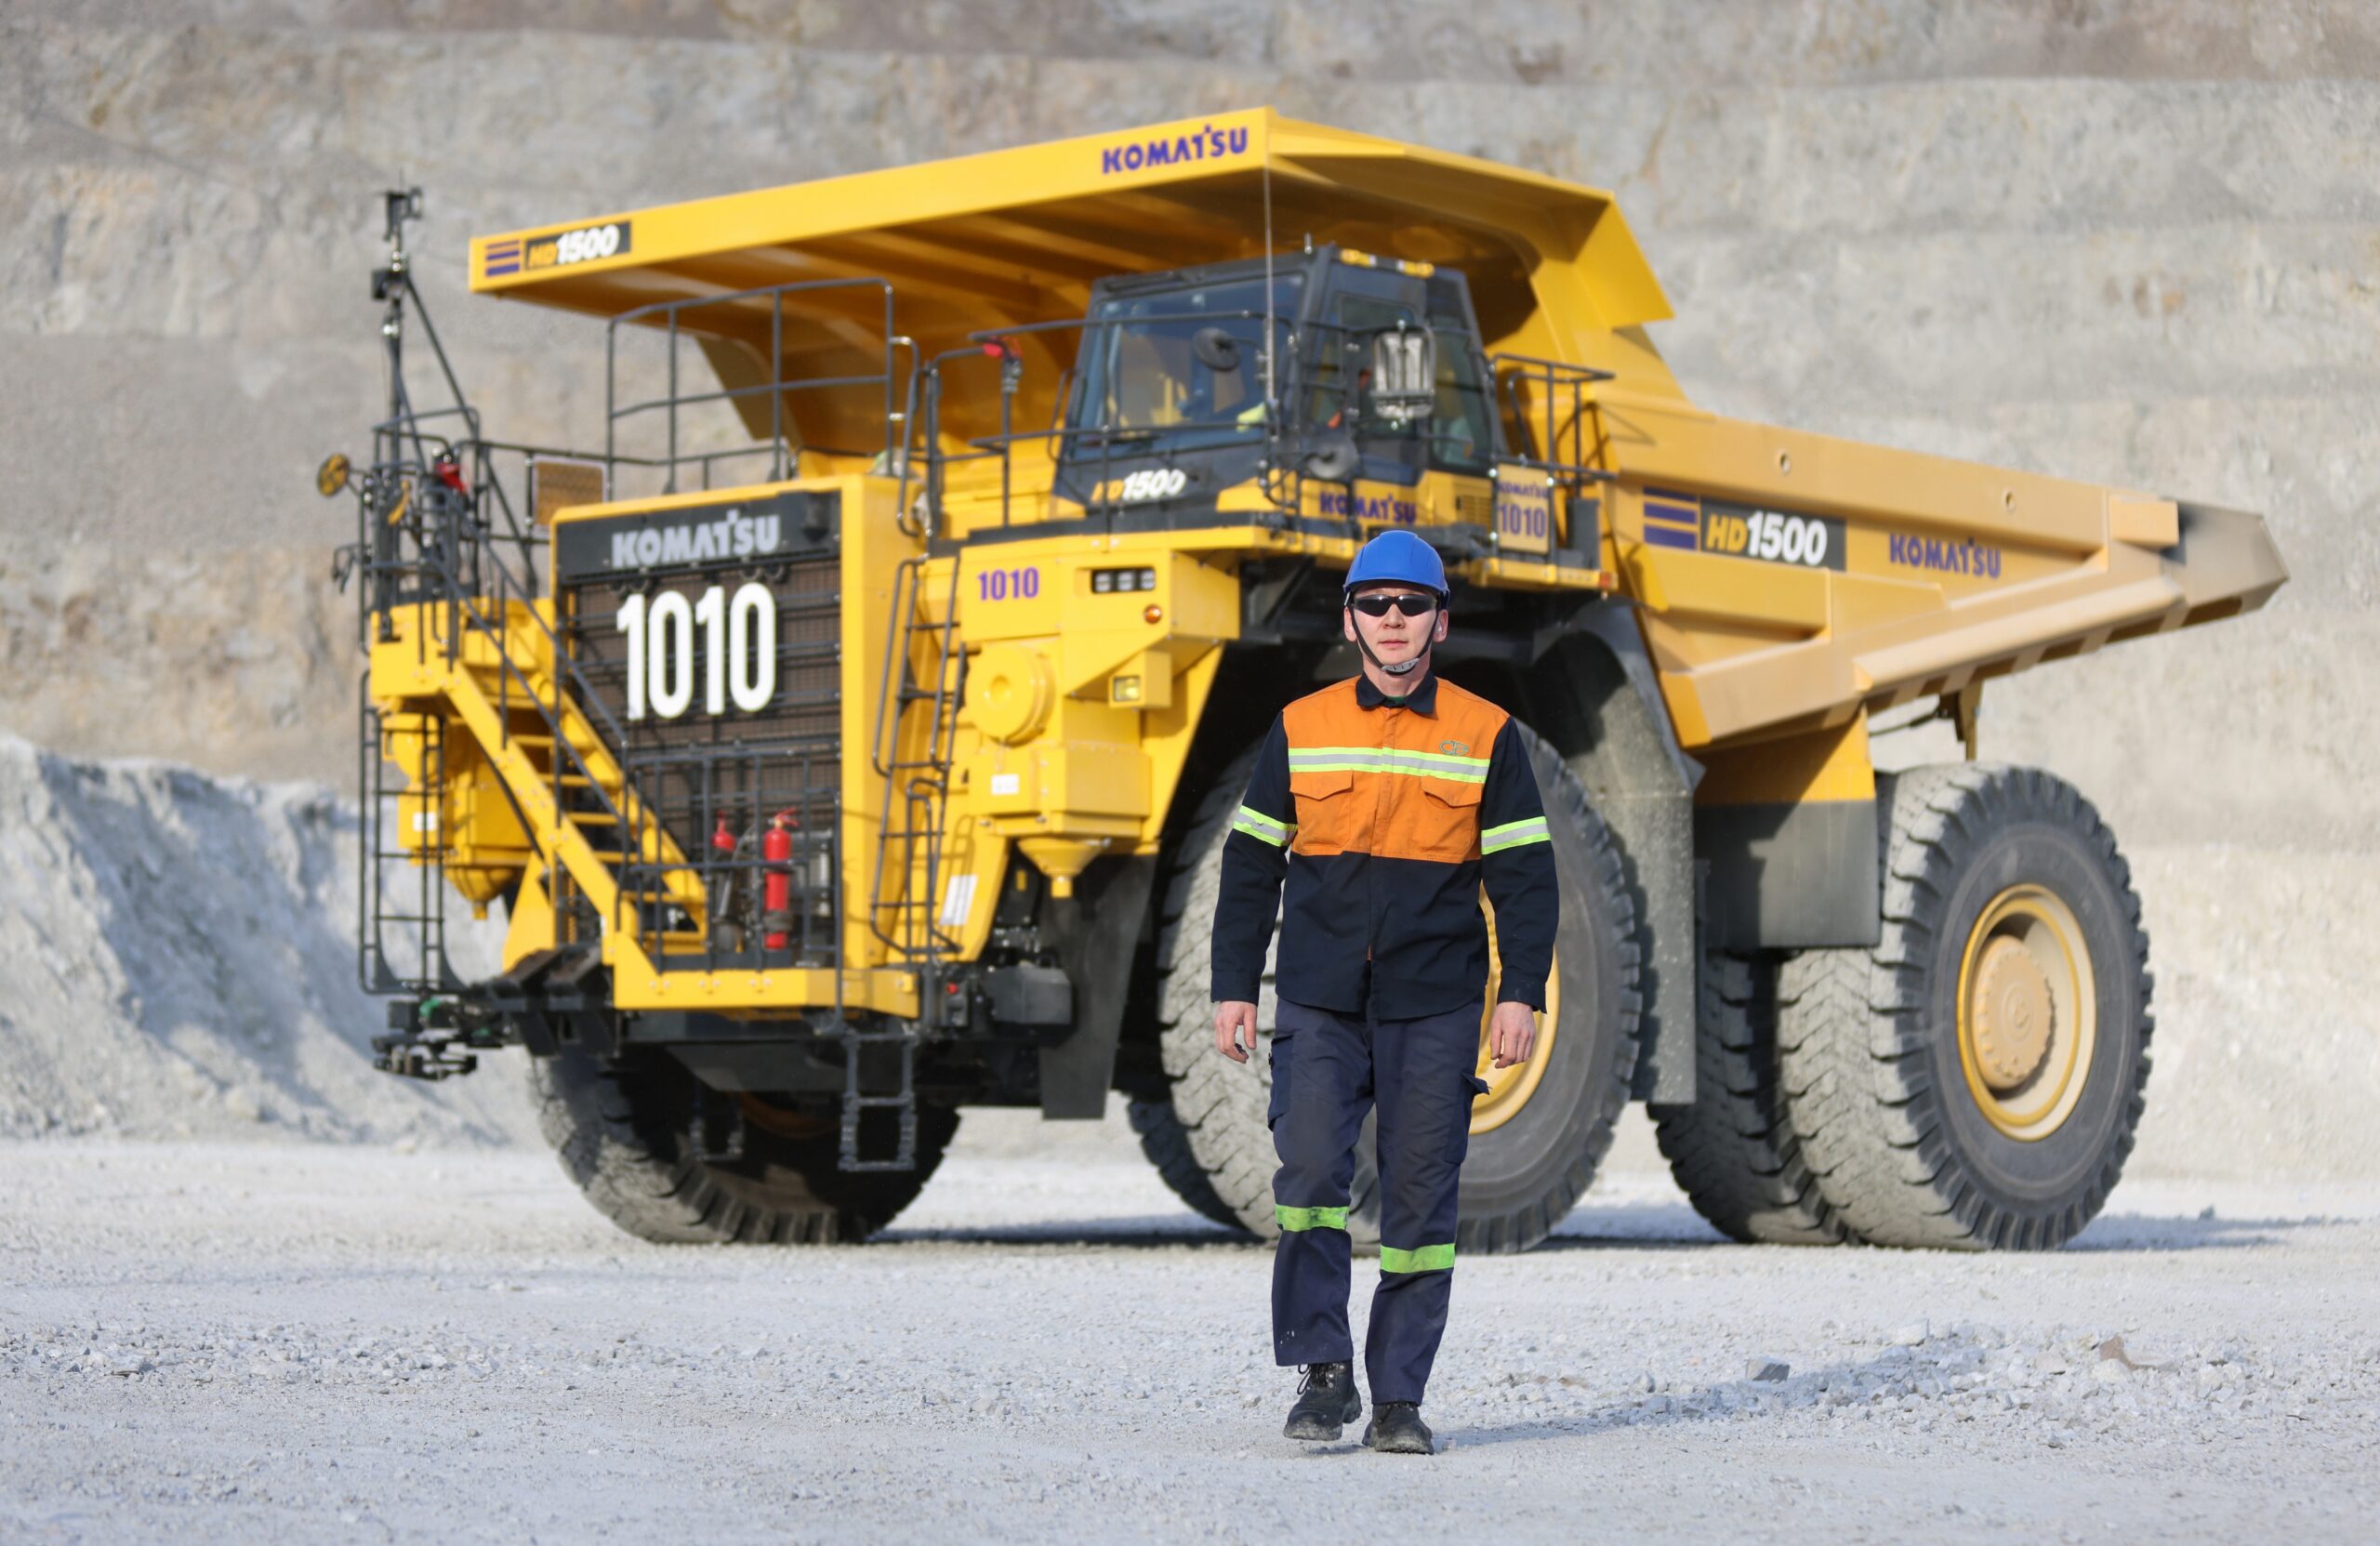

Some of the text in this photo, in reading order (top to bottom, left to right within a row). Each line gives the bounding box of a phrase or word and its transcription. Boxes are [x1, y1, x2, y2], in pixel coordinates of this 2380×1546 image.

[1103, 124, 1248, 174] KOMATSU
[529, 224, 619, 267] HD1500
[612, 509, 780, 569] KOMATSU
[1500, 504, 1546, 538] 1010
[1706, 510, 1828, 565] HD1500
[1889, 532, 2001, 578] KOMATSU
[978, 566, 1039, 601] 1010
[616, 582, 776, 720] 1010
